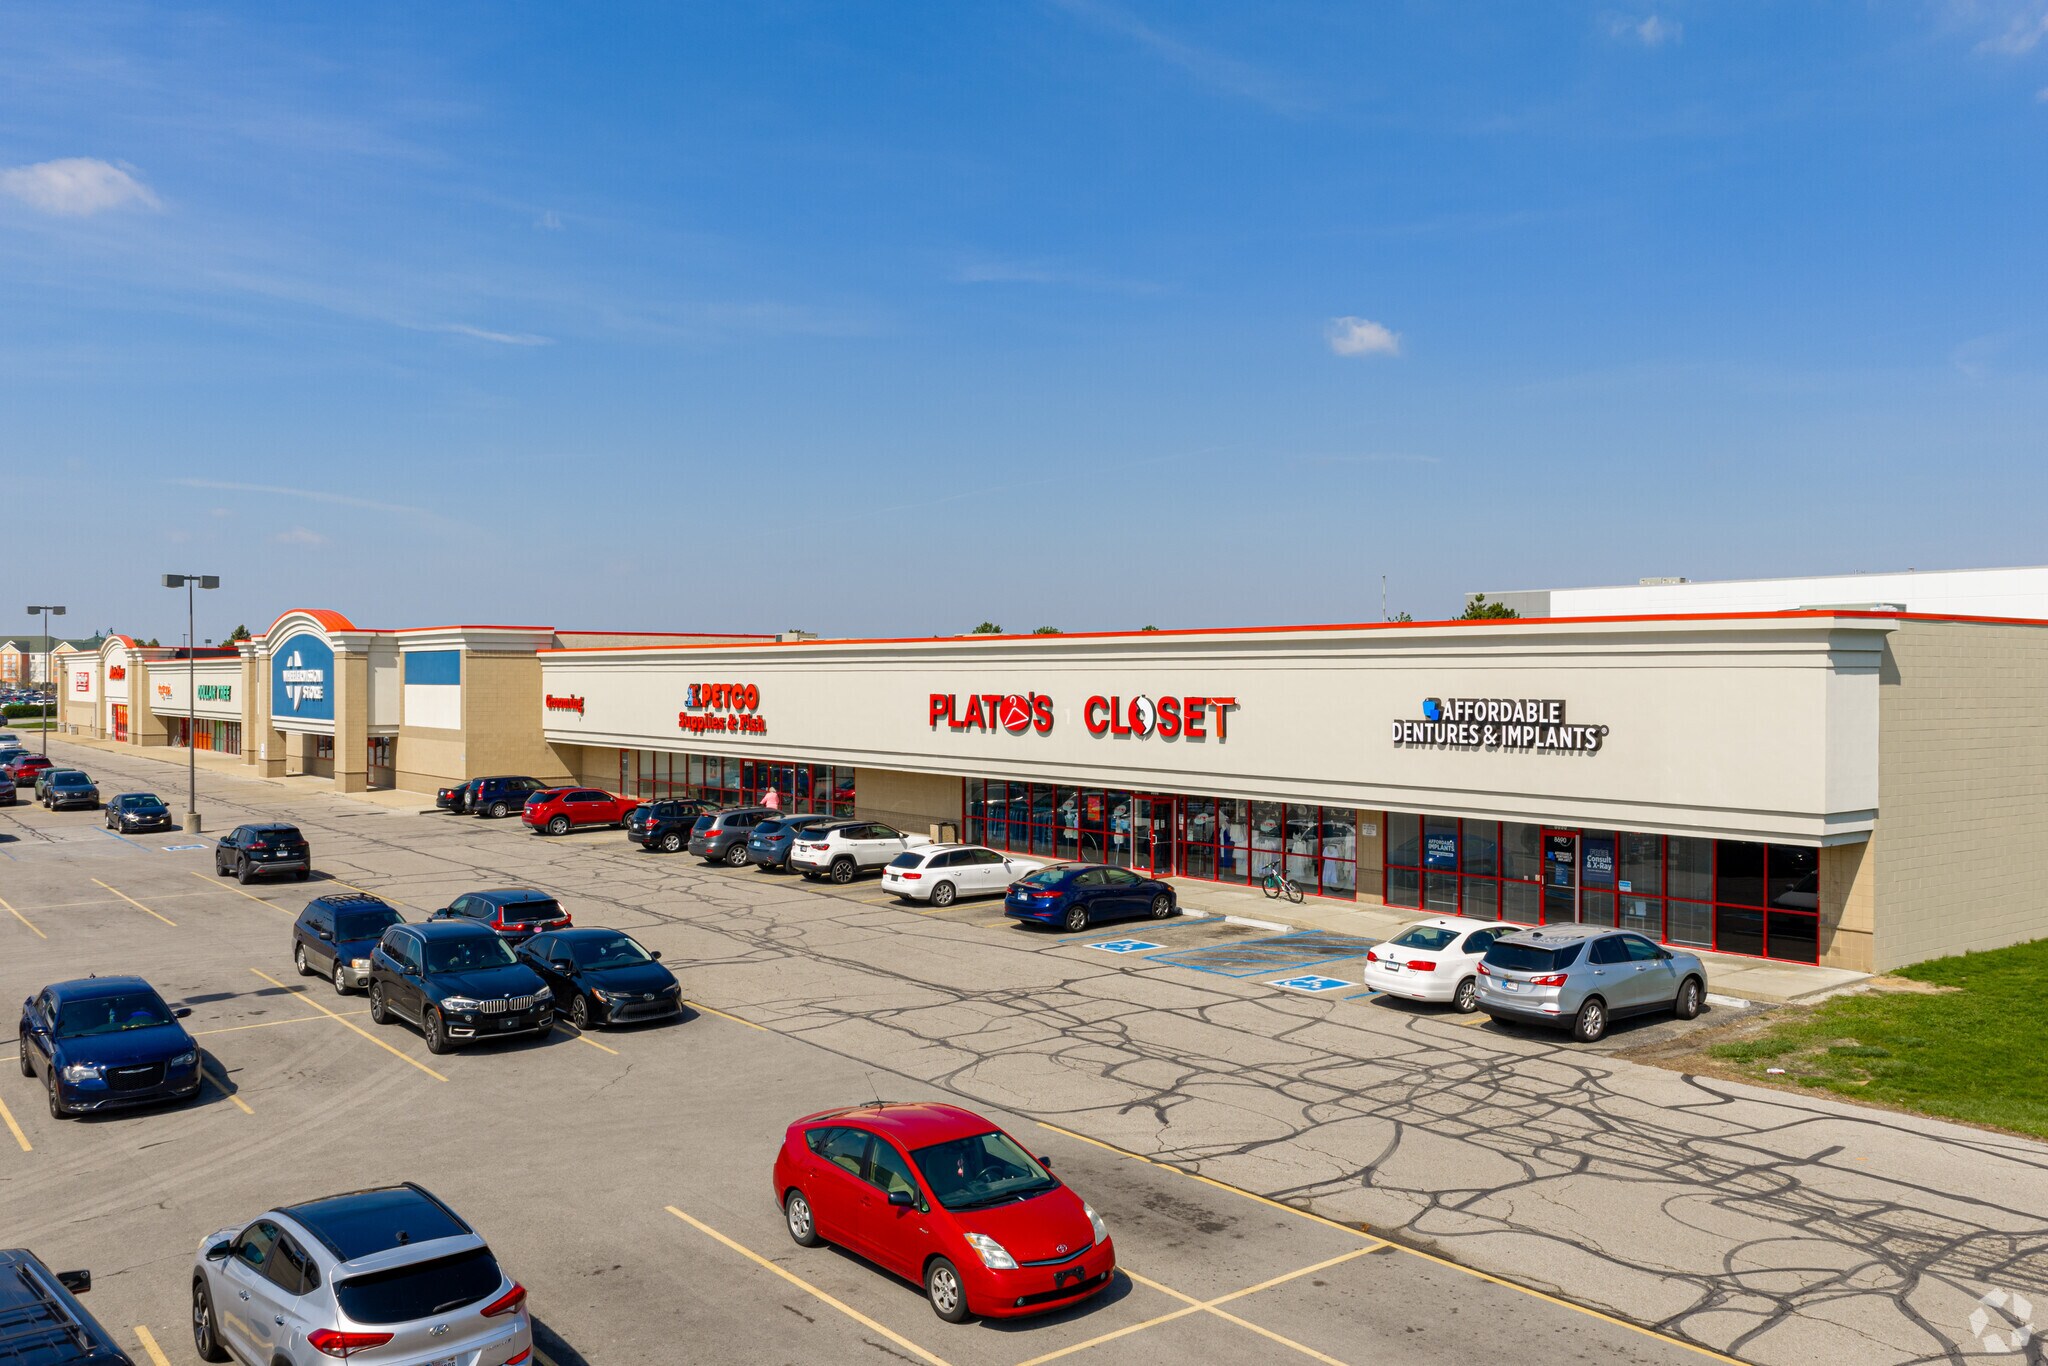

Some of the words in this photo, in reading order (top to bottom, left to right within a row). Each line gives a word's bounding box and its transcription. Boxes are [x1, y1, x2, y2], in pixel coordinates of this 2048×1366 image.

[218, 685, 231, 702] TREE
[546, 694, 583, 713] Grooming
[701, 683, 758, 710] PETCO
[679, 712, 725, 732] Supplies
[727, 714, 738, 731] &
[739, 714, 765, 732] Fish
[929, 691, 1053, 732] PLATO'S
[1083, 694, 1239, 738] CLOSET
[1442, 701, 1560, 723] AFFORDABLE
[1392, 722, 1479, 744] DENTURES
[1483, 724, 1498, 745] &
[1587, 855, 1611, 864] Consult
[1593, 862, 1612, 871] X-Ray
